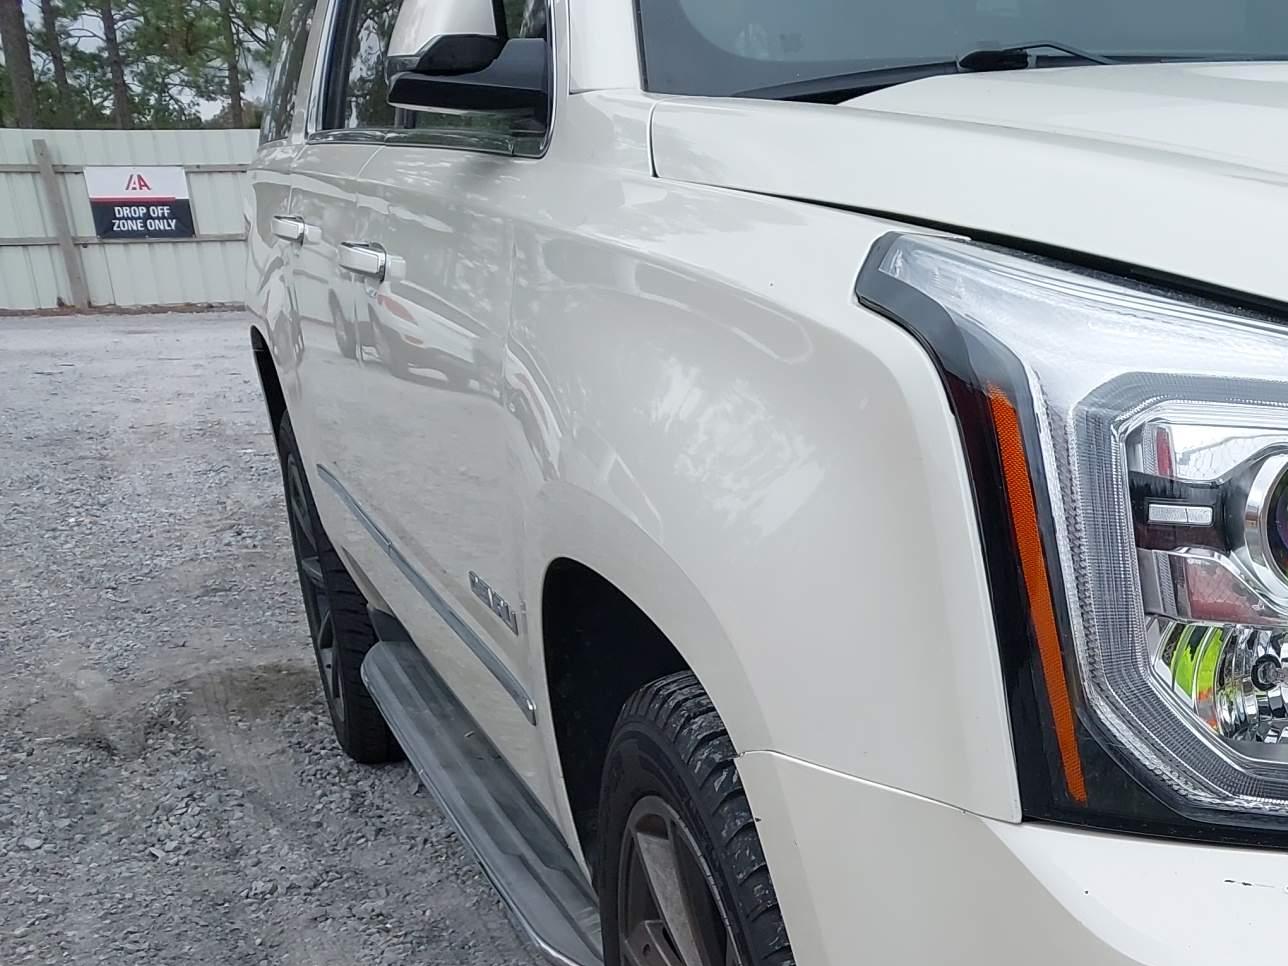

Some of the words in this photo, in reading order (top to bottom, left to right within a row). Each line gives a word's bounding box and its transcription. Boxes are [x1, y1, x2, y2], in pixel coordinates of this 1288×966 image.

[114, 206, 147, 218] DROP
[149, 206, 171, 218] OFF
[112, 219, 145, 231] ZONE
[146, 219, 177, 231] ONLY
